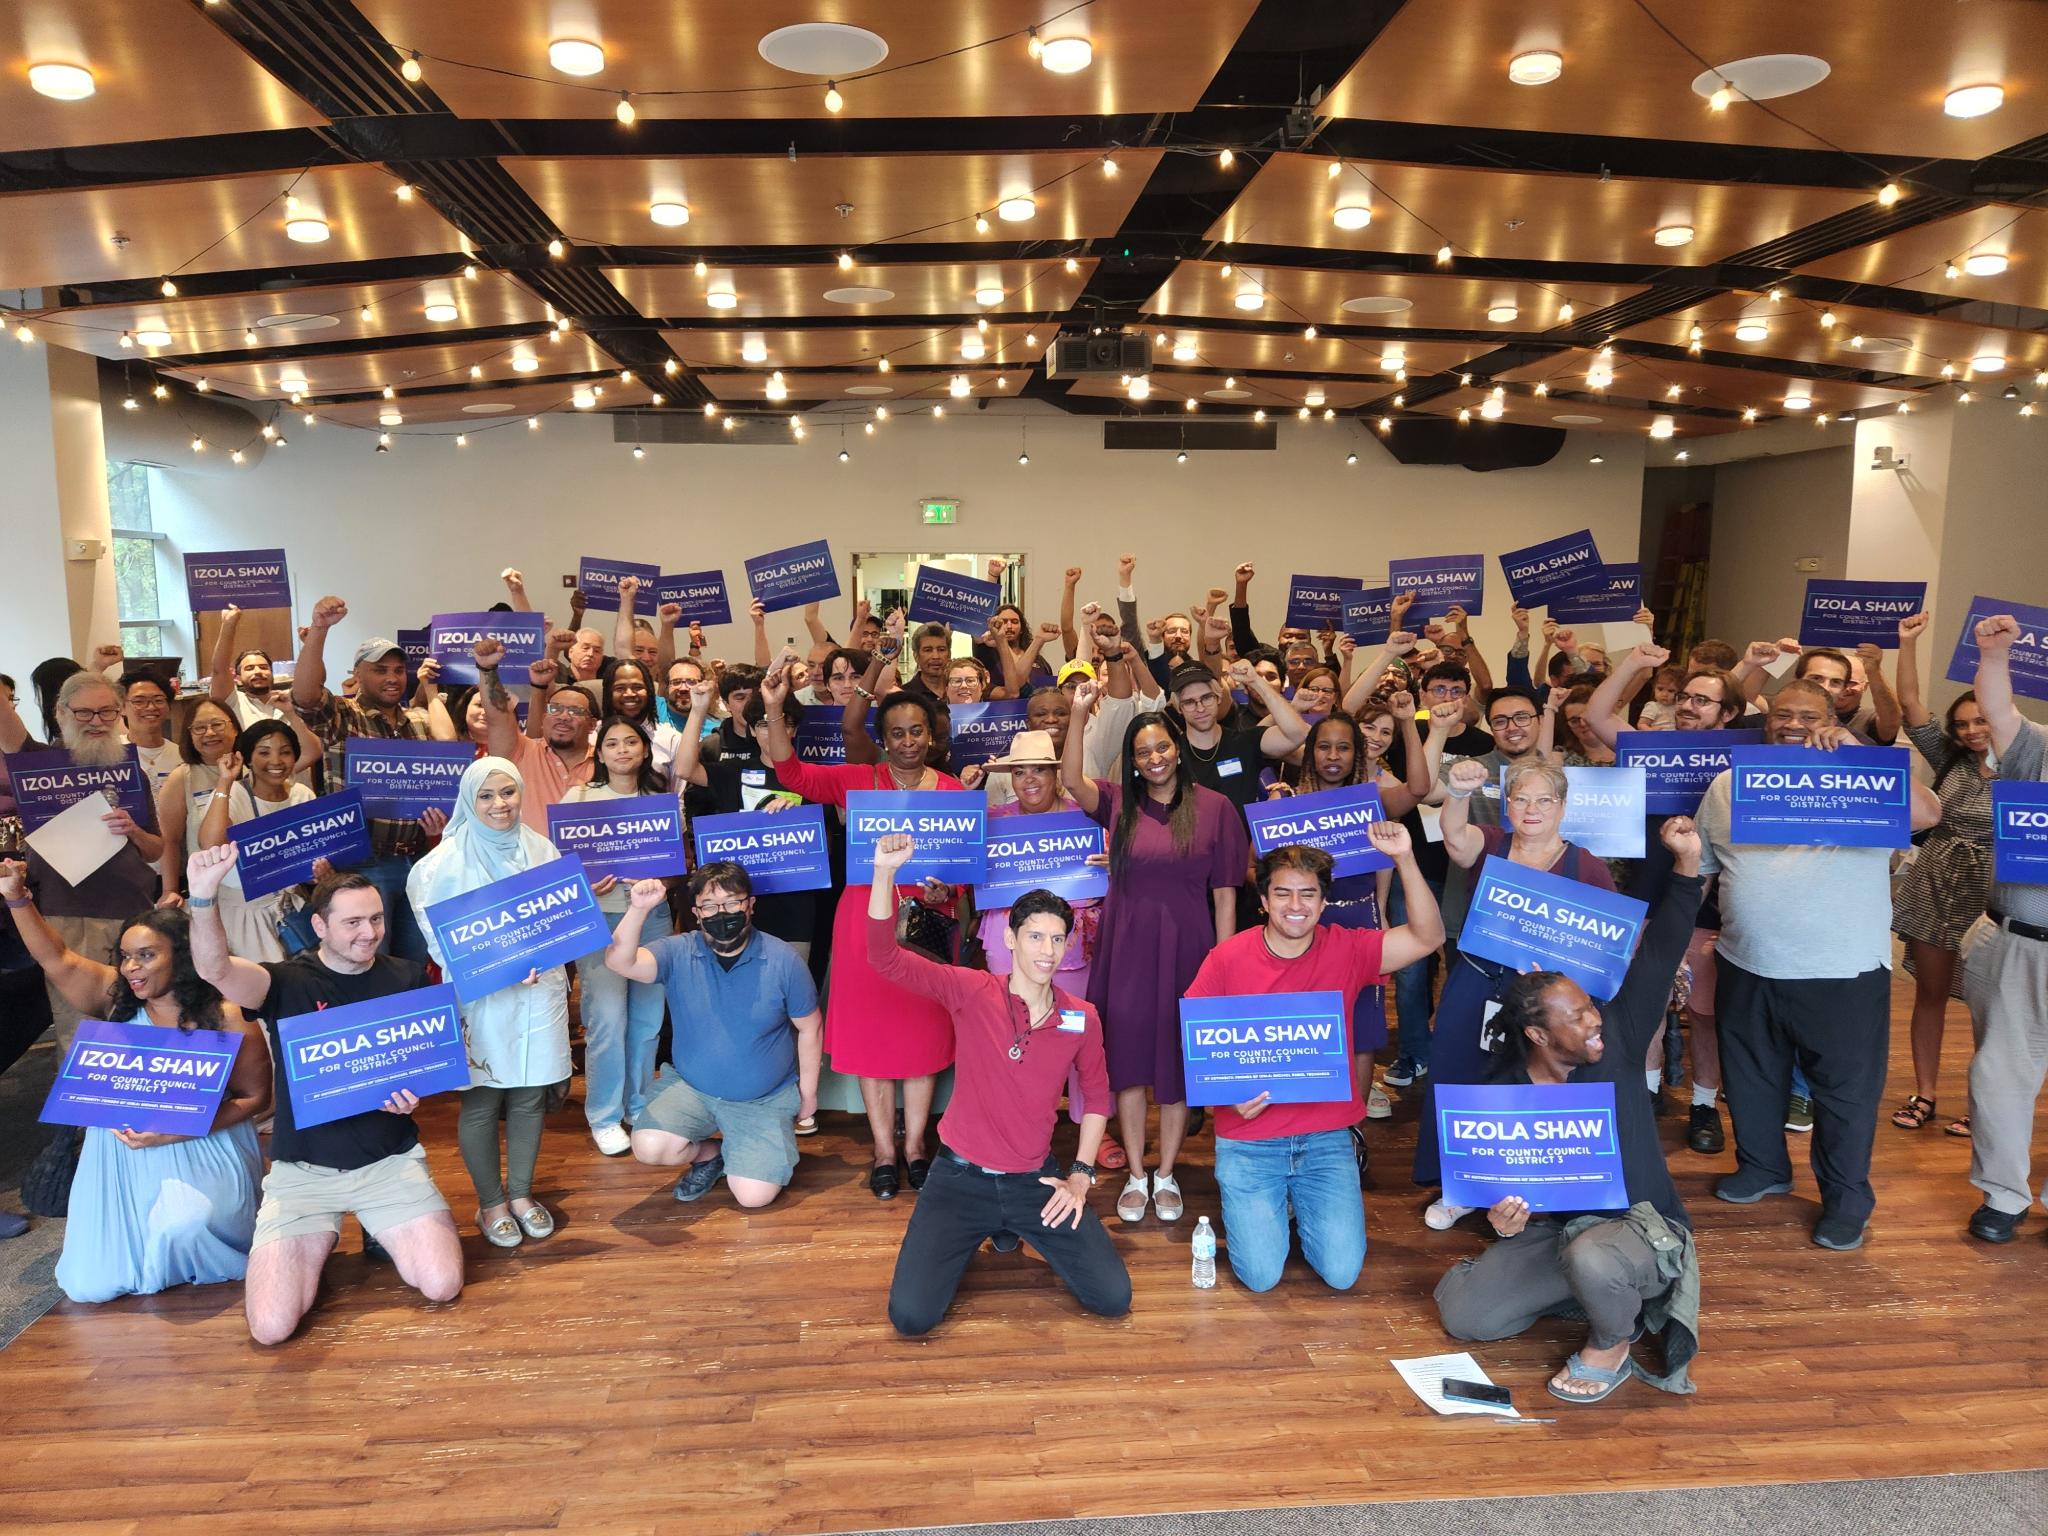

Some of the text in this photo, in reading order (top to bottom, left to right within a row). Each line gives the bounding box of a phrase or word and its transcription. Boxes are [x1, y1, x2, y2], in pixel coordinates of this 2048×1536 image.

[754, 557, 825, 583] IZOLA SHAW
[1511, 549, 1589, 579] IZOLA SHAW
[194, 566, 280, 579] IZOLA SHAW
[585, 572, 618, 583] IZOLA
[1397, 572, 1476, 587] IZOLA SHAW
[661, 586, 720, 599] IZOLA SHAW
[1609, 580, 1635, 590] AW
[921, 582, 991, 607] IZOLA SHAW
[1296, 590, 1340, 601] IZOLA SH
[1348, 605, 1383, 616] IZOLA
[1814, 599, 1915, 613] IZOLA SHAW
[438, 632, 483, 644] IZOLA
[405, 645, 430, 655] IZOL
[957, 720, 1027, 734] IZOLA SHA
[1628, 754, 1732, 767] IZOLA SHA
[356, 761, 465, 776] IZOLA SHAW
[20, 768, 130, 792] IZOLA SHAW
[1746, 773, 1896, 791] IZOLA SHAW
[1573, 793, 1632, 807] SHAW
[1760, 794, 1880, 804] FOR COUNTY COUNCIL
[1790, 801, 1837, 809] DISTRICT
[859, 818, 976, 832] IZOLA SHAW
[1261, 808, 1372, 840] IZOLA SHAW
[2009, 811, 2048, 828] IZO
[244, 810, 354, 857] IZOLA SHAW
[561, 818, 671, 840] IZOLA SHAW
[592, 840, 624, 848] COUNTY
[626, 836, 662, 845] COUNCIL
[706, 829, 815, 853] IZOLA SHAW
[1296, 829, 1367, 846] COUNTY COUNCIL
[1308, 839, 1338, 848] ISTRICT
[259, 830, 348, 863] FOR COUNTY COUNCIL
[283, 843, 318, 860] DISTRICT
[597, 844, 632, 853] DISTRICT
[986, 835, 1093, 858] ZOLA SHAW
[738, 852, 769, 861] COUNTY
[771, 848, 807, 857] COUNCIL
[743, 856, 777, 866] DISTRICT
[995, 855, 1083, 869] FOR COUNTY COUNCIL
[1019, 862, 1053, 872] DISTRICT
[450, 883, 578, 945] IZOLA SHAW
[1487, 886, 1625, 942] IZOLA SHAW
[471, 908, 575, 953] FOR COUNTY COUNCIL
[501, 923, 552, 948] DISTRICT 3
[1496, 910, 1603, 951] FOR COUNTY COUNCIL
[1521, 925, 1574, 948] DISTRICT 3
[299, 1015, 445, 1065] IZOLA SHAW
[1195, 1023, 1331, 1045] IZOLA SHAW
[318, 1041, 436, 1075] FOR COUNTY COUNCIL
[1210, 1046, 1319, 1059] FOR COUNTY COUNCIL
[1238, 1055, 1282, 1064] DISTRICT
[78, 1050, 220, 1078] IZOLA SHAW
[351, 1054, 408, 1074] DISTRICT 3
[86, 1073, 197, 1090] FOR COUNTY COUNCIL
[112, 1082, 159, 1093] DISTRICT
[1454, 1119, 1603, 1140] IZOLA SHAW
[1472, 1147, 1591, 1157] FOR COUNTY COUNCIL
[1505, 1156, 1563, 1165] DISTRICT 3
